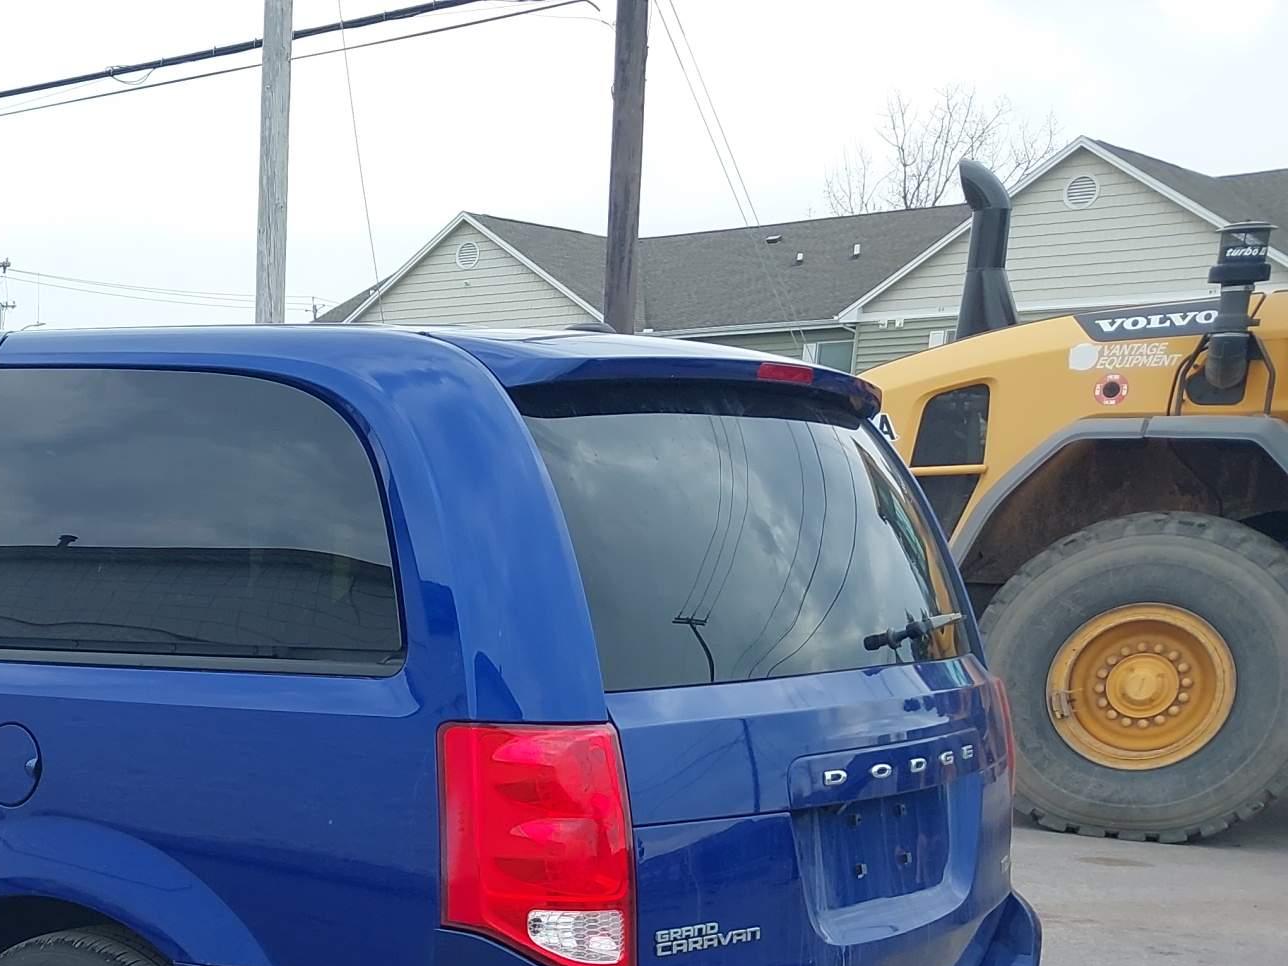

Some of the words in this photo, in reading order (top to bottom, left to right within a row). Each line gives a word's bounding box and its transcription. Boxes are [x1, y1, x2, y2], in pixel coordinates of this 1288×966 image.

[1225, 246, 1259, 257] turbo
[1094, 309, 1219, 333] VOLVO
[1101, 342, 1169, 357] VANTAGE
[1096, 353, 1183, 370] EQUIPMENT
[824, 744, 974, 786] DODGE
[655, 922, 719, 943] GRAND
[655, 927, 761, 957] CARAVAN
